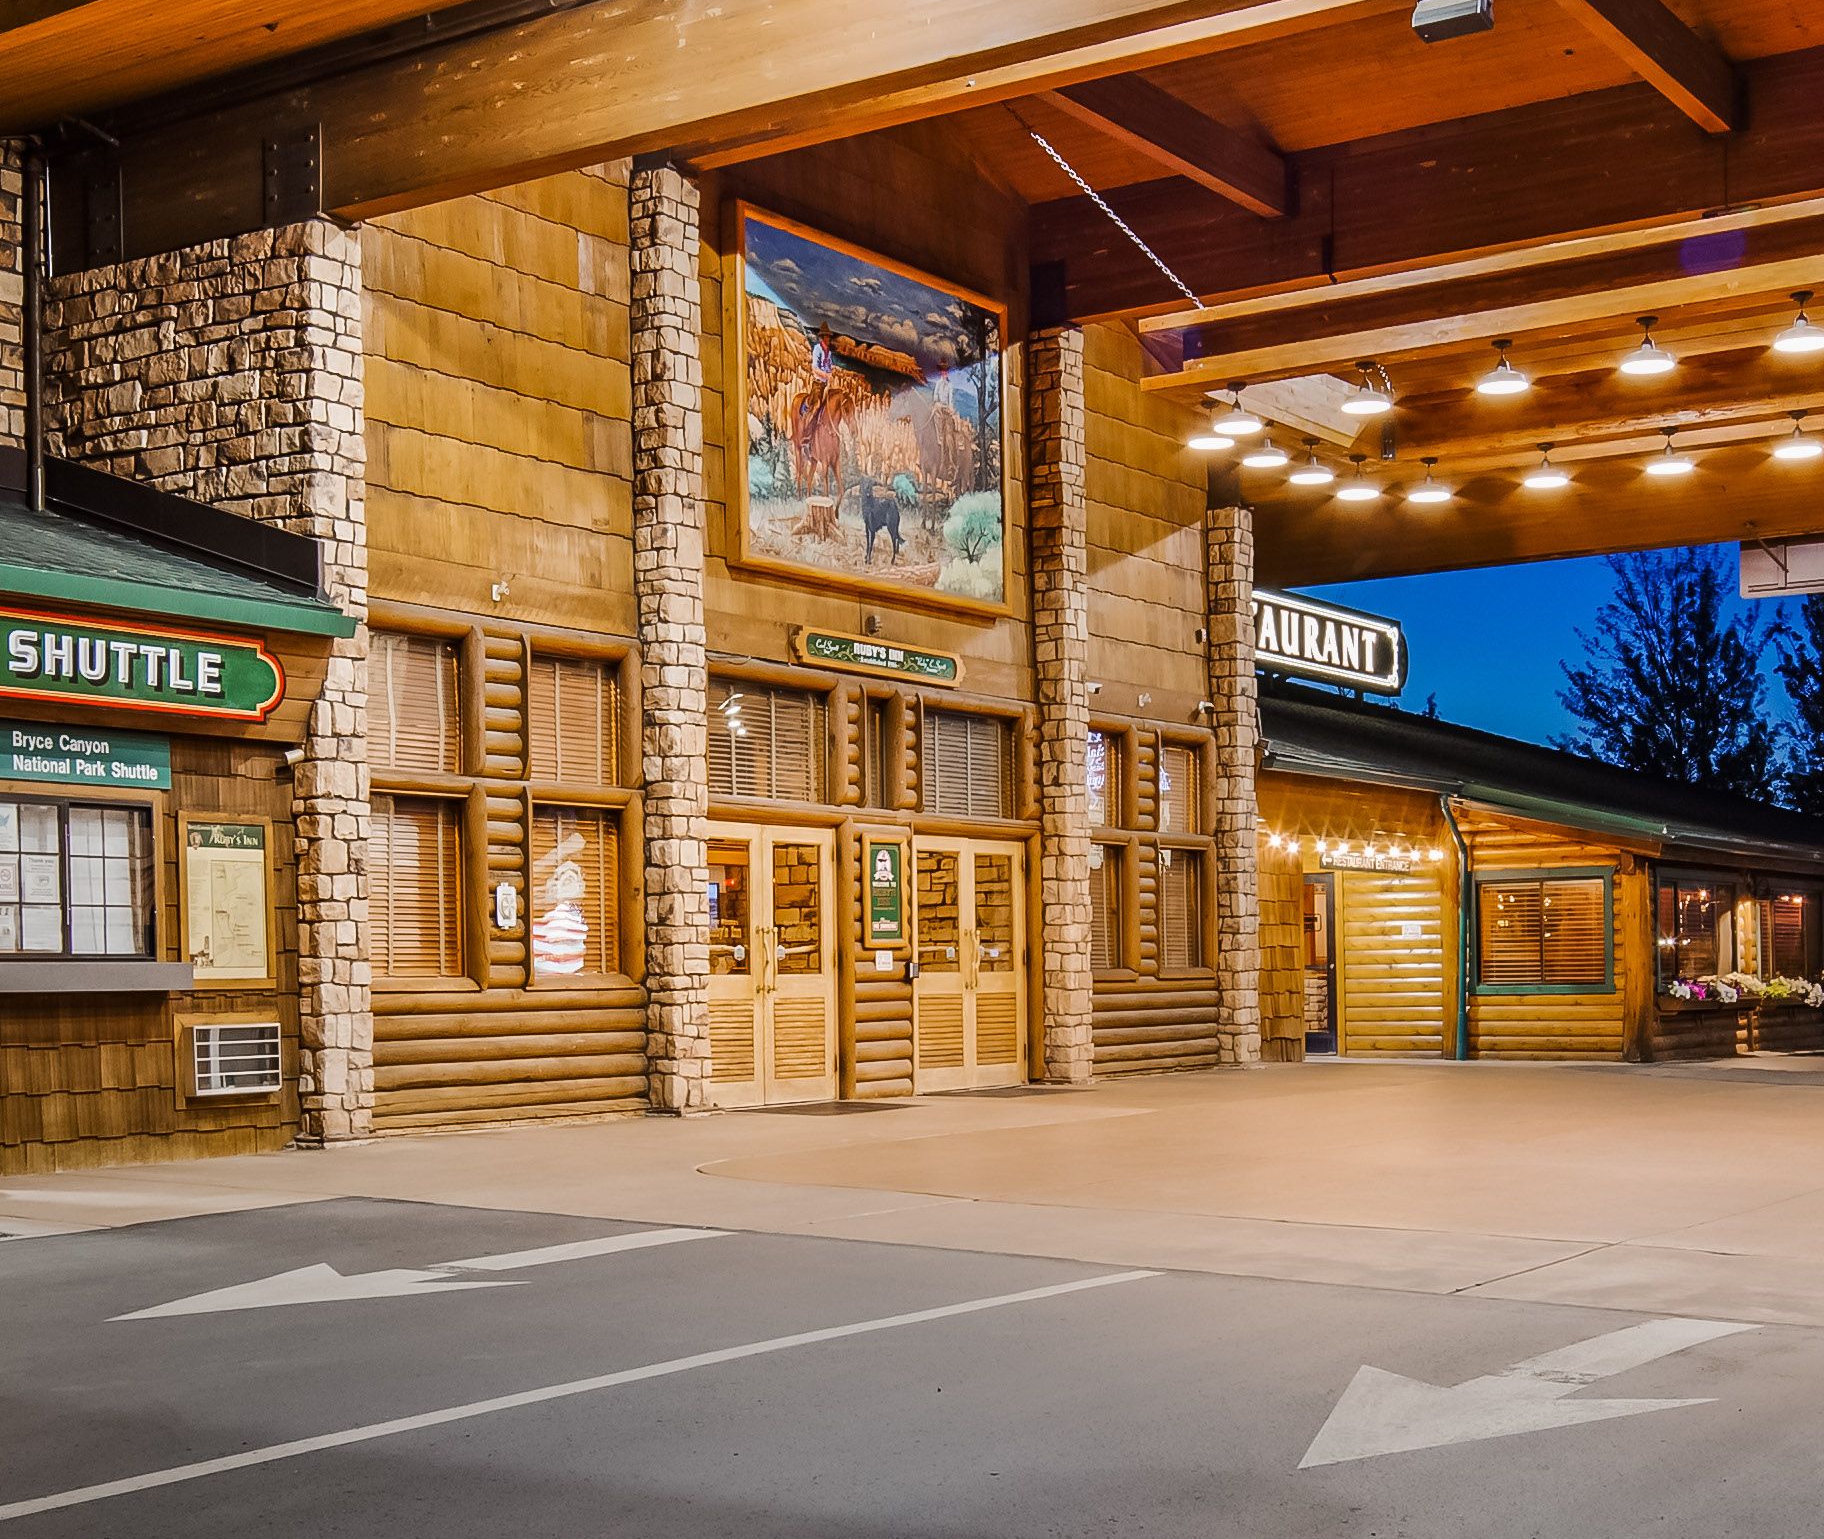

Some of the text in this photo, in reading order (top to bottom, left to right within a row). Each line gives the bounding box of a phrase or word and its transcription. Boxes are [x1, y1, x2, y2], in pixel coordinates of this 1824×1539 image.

[7, 629, 222, 694] SHUTTLE
[853, 642, 887, 659] RUBY'S
[12, 730, 110, 755] Bryce Canyon
[12, 755, 159, 781] National Park Shuttle
